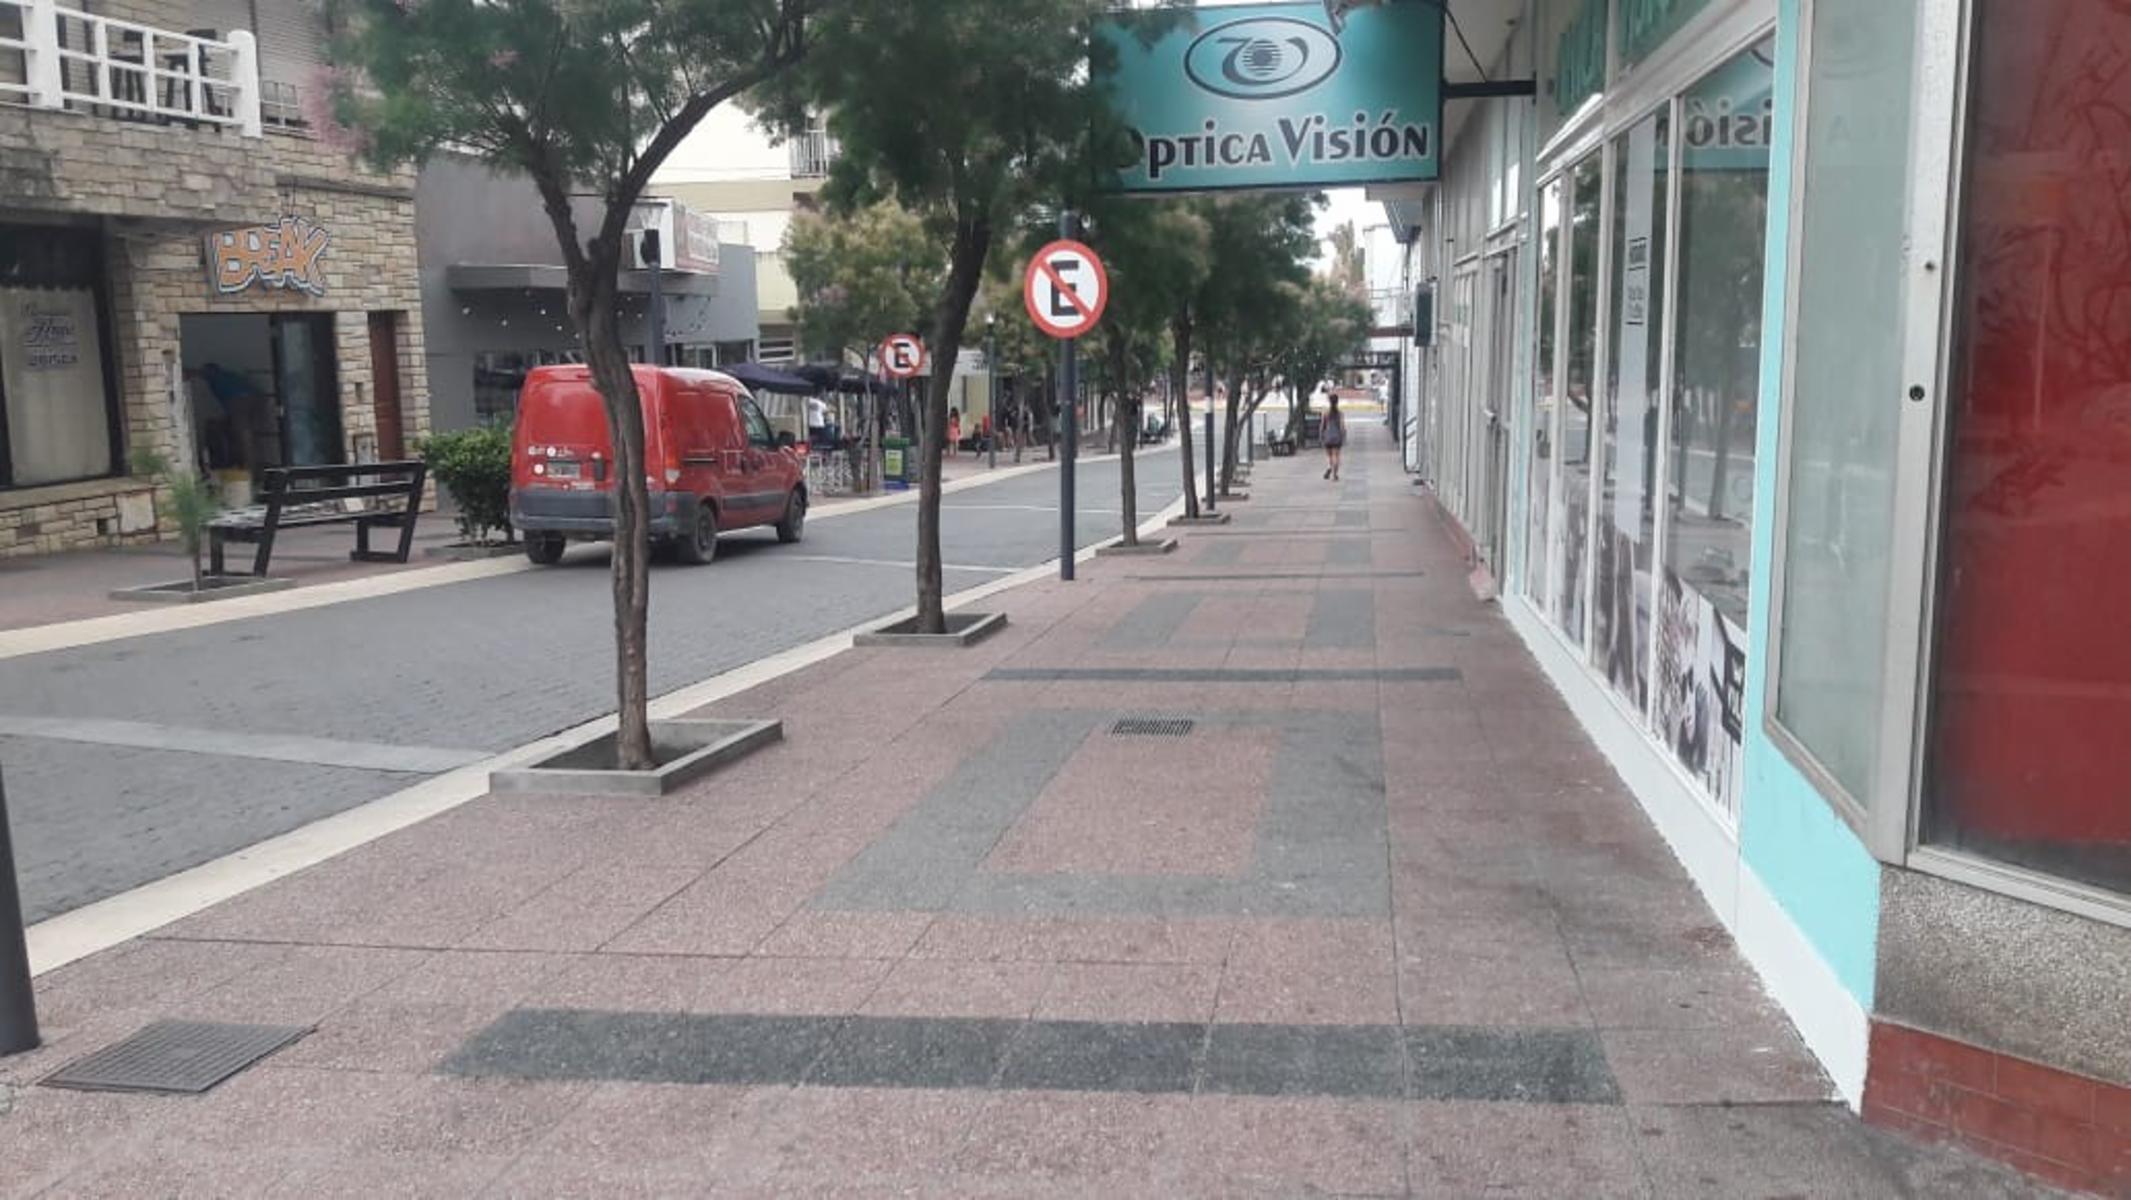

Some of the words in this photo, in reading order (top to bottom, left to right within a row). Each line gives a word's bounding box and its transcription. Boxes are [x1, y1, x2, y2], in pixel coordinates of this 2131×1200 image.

[213, 217, 330, 295] BREAK
[1051, 260, 1079, 316] E
[894, 342, 910, 368] E
